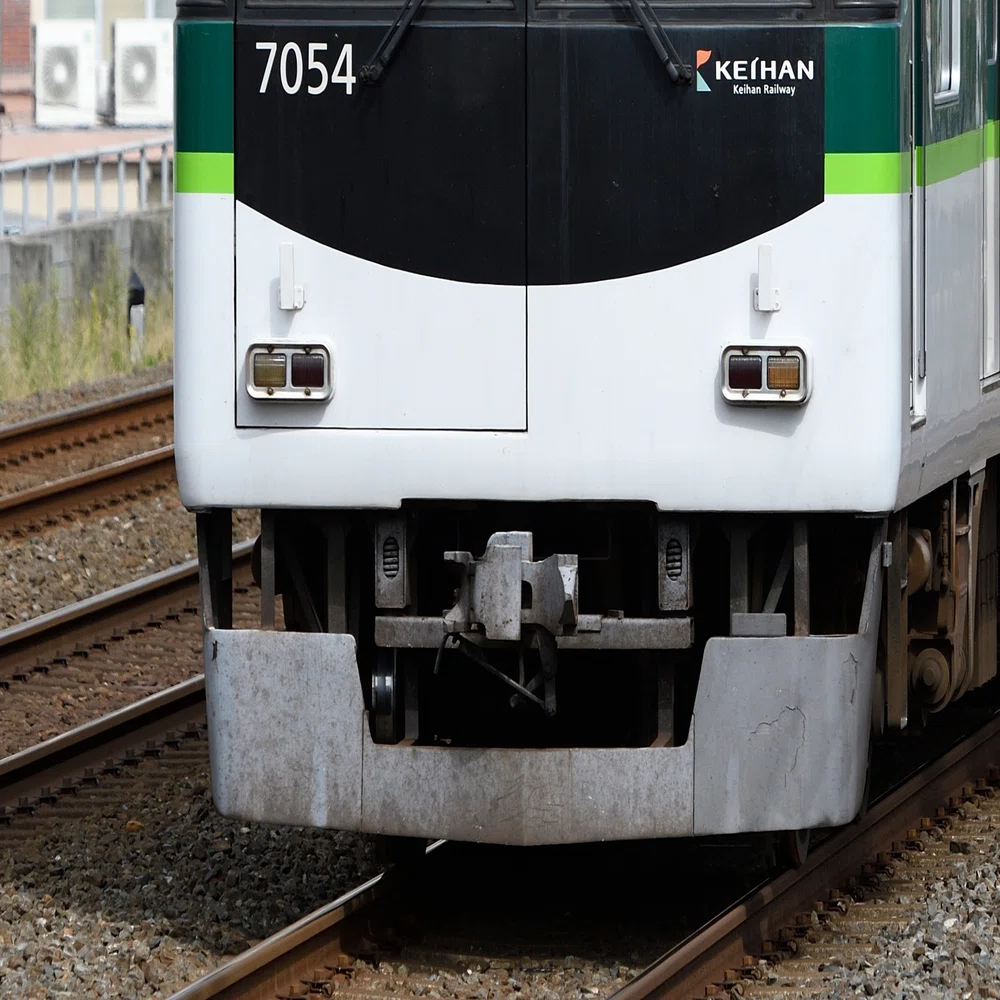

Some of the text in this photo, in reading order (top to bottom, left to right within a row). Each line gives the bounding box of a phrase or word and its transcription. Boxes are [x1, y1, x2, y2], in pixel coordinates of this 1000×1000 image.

[255, 42, 356, 95] 7054
[715, 57, 814, 80] KEIHAN
[733, 84, 796, 97] Keihan Railway
